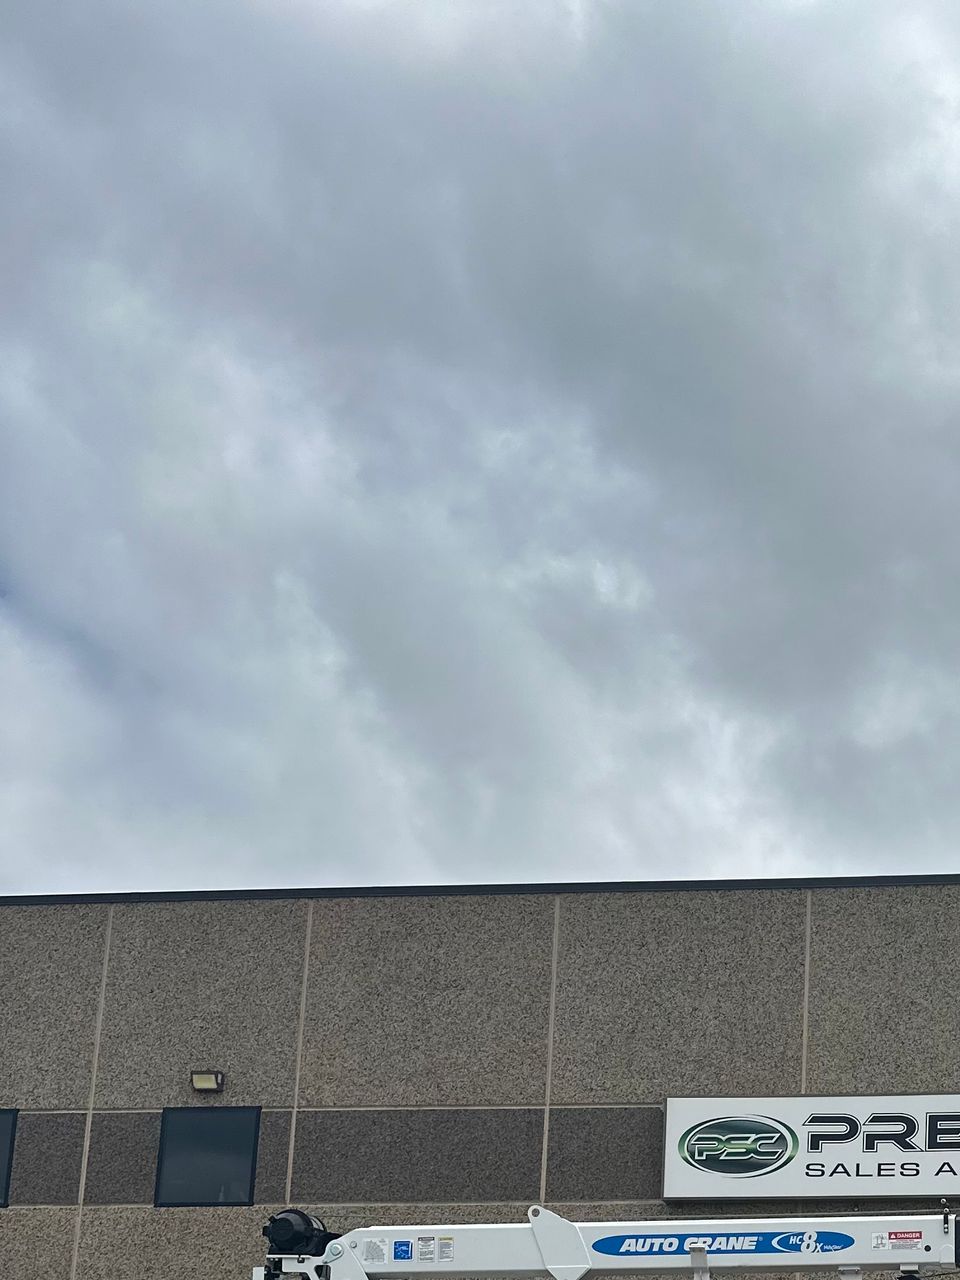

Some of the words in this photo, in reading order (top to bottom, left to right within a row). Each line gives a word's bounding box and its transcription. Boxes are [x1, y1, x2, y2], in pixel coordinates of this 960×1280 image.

[691, 1133, 784, 1160] PSC
[804, 1161, 920, 1178] SALES
[619, 1238, 680, 1253] AUTO
[683, 1236, 758, 1252] CRANE
